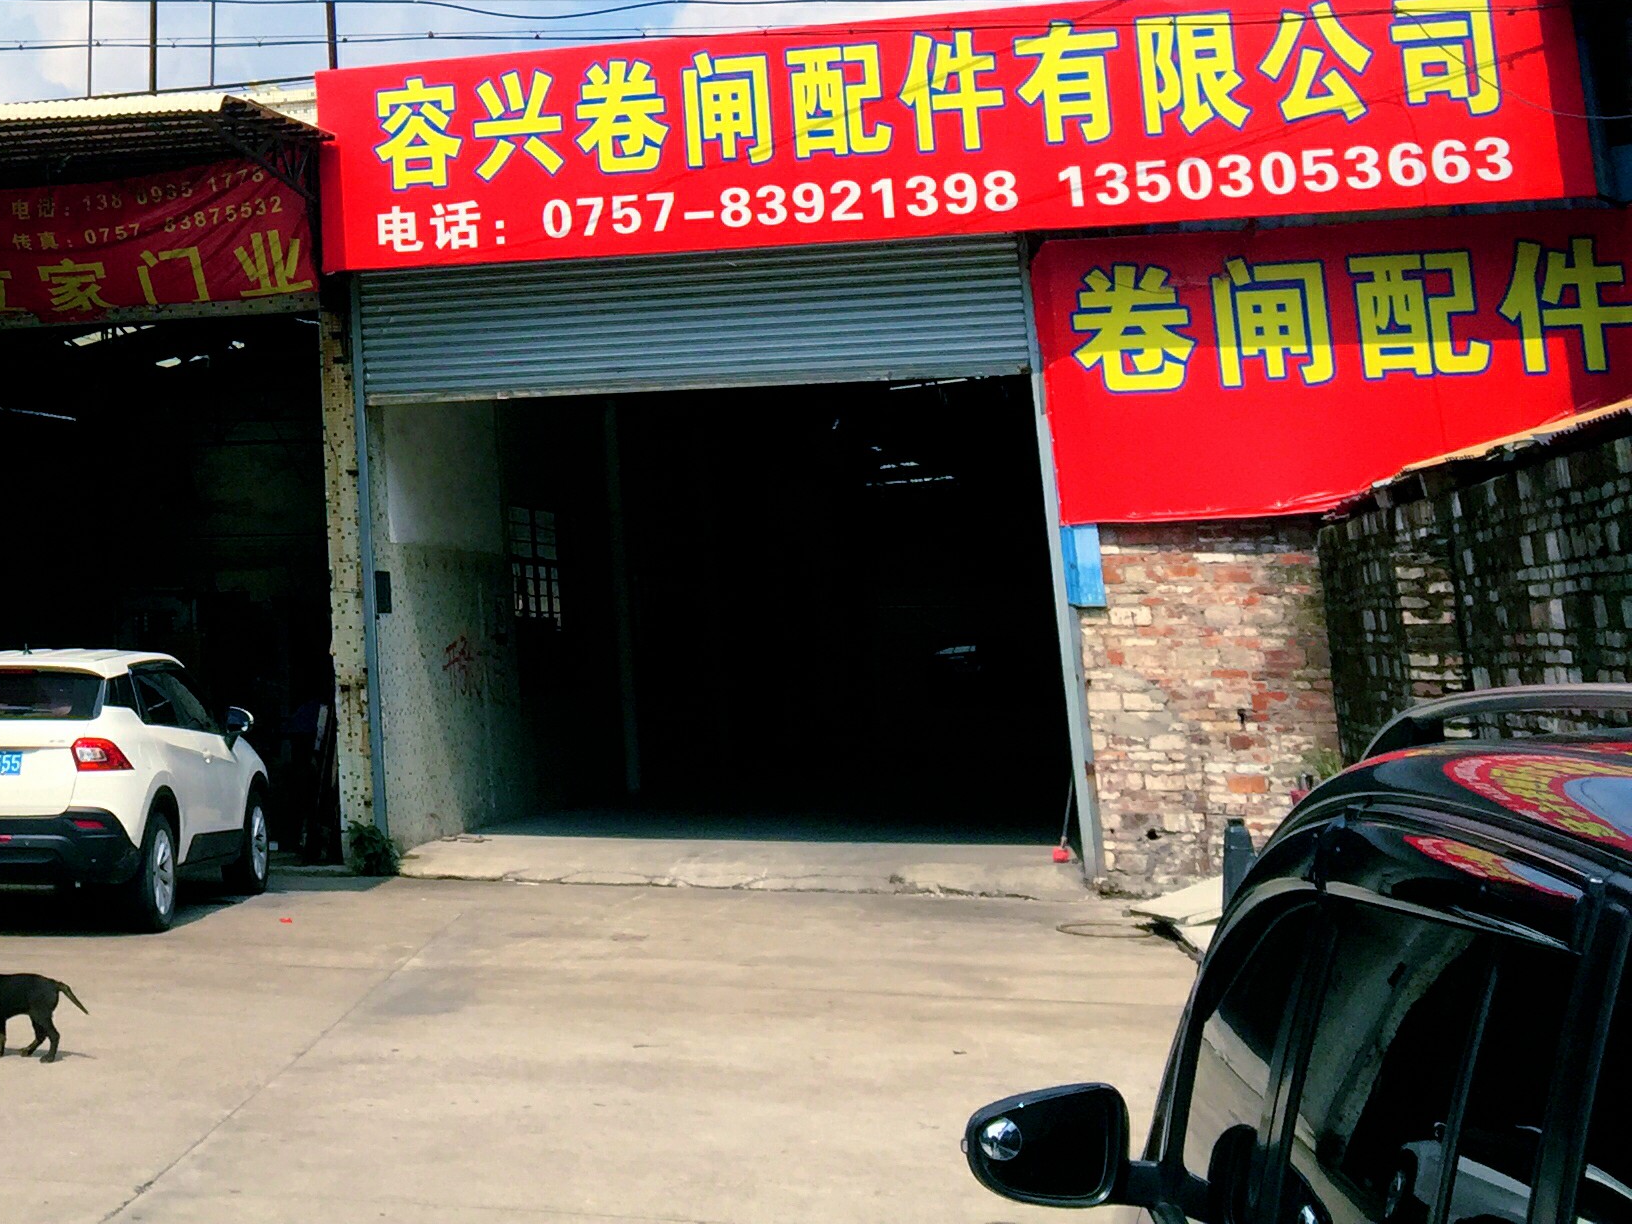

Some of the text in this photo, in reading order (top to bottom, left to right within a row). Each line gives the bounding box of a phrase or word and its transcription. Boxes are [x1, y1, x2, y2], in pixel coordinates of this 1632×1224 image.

[376, 136, 1514, 253] 电话： 0757-83921398 13503053663
[1071, 238, 1632, 392] 卷闸配件
